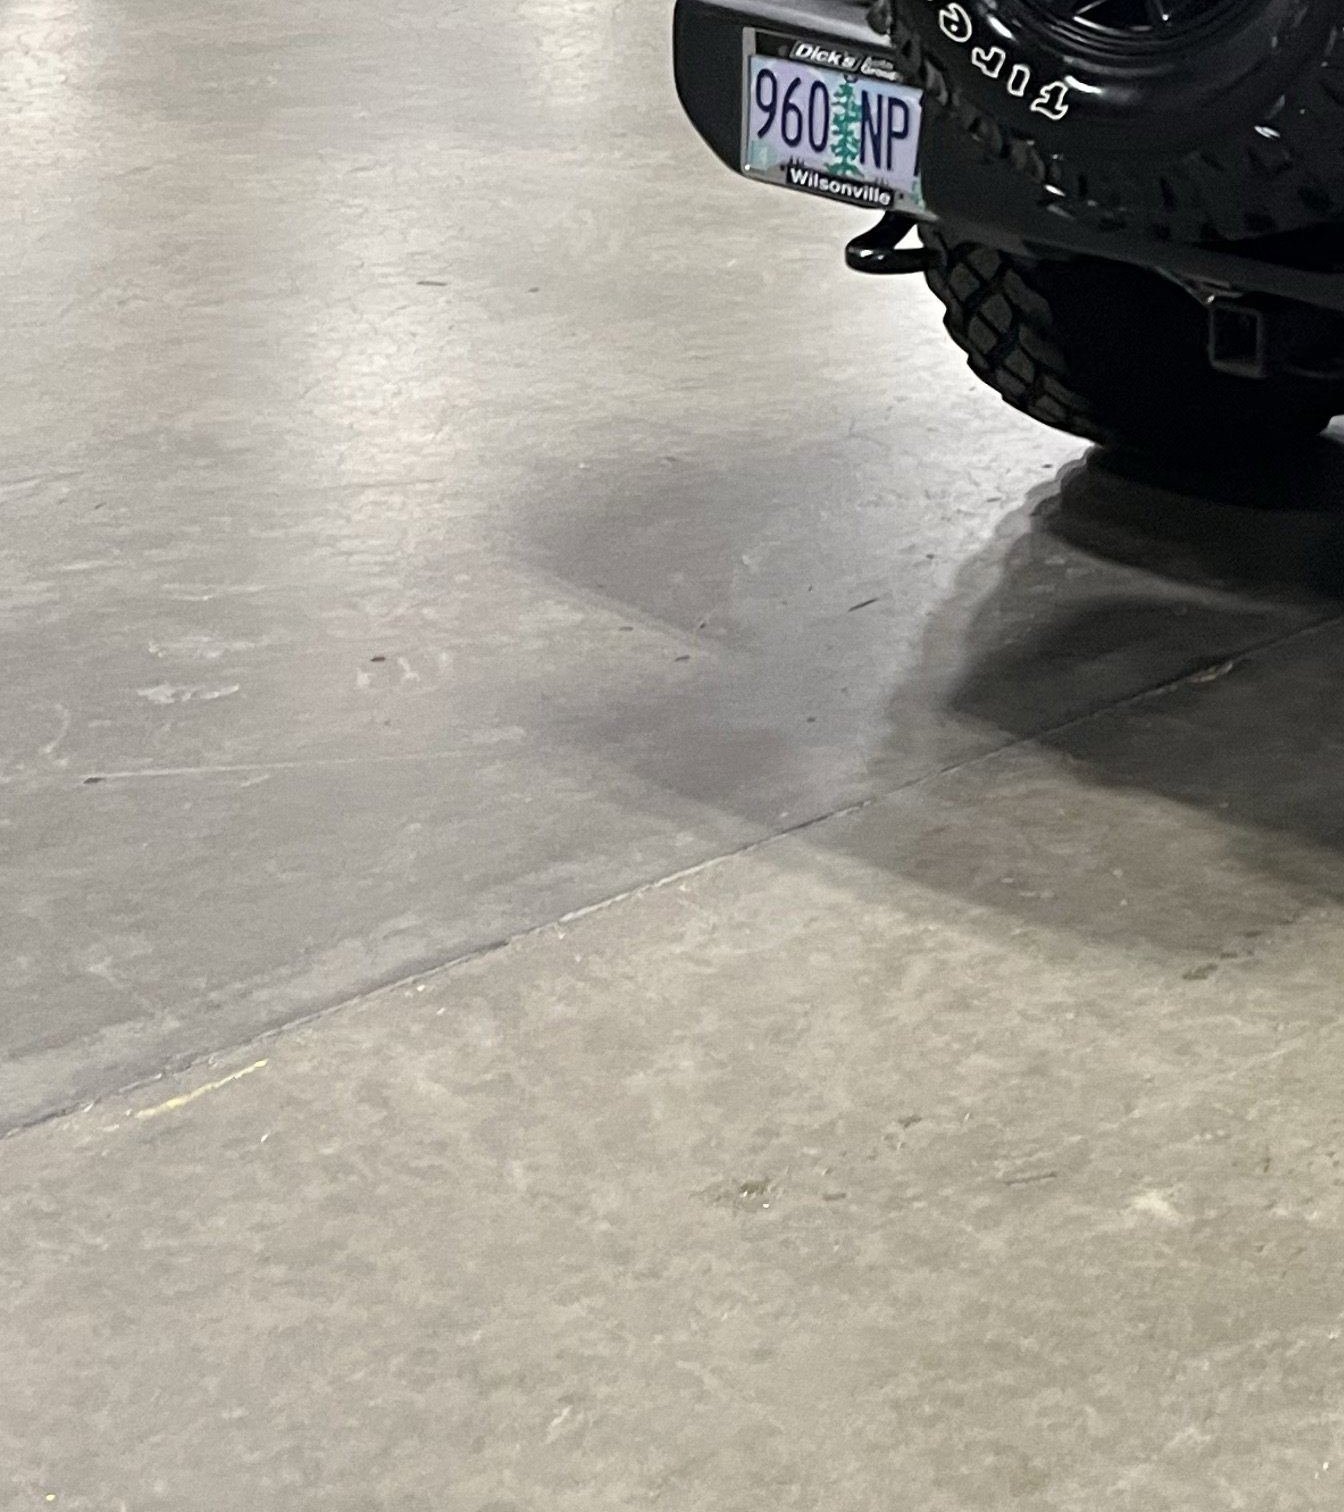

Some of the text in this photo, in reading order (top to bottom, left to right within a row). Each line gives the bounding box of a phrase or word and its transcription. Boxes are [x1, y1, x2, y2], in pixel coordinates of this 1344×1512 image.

[795, 43, 856, 69] Dick's
[755, 68, 830, 153] 960
[790, 166, 891, 206] Wilsonville
